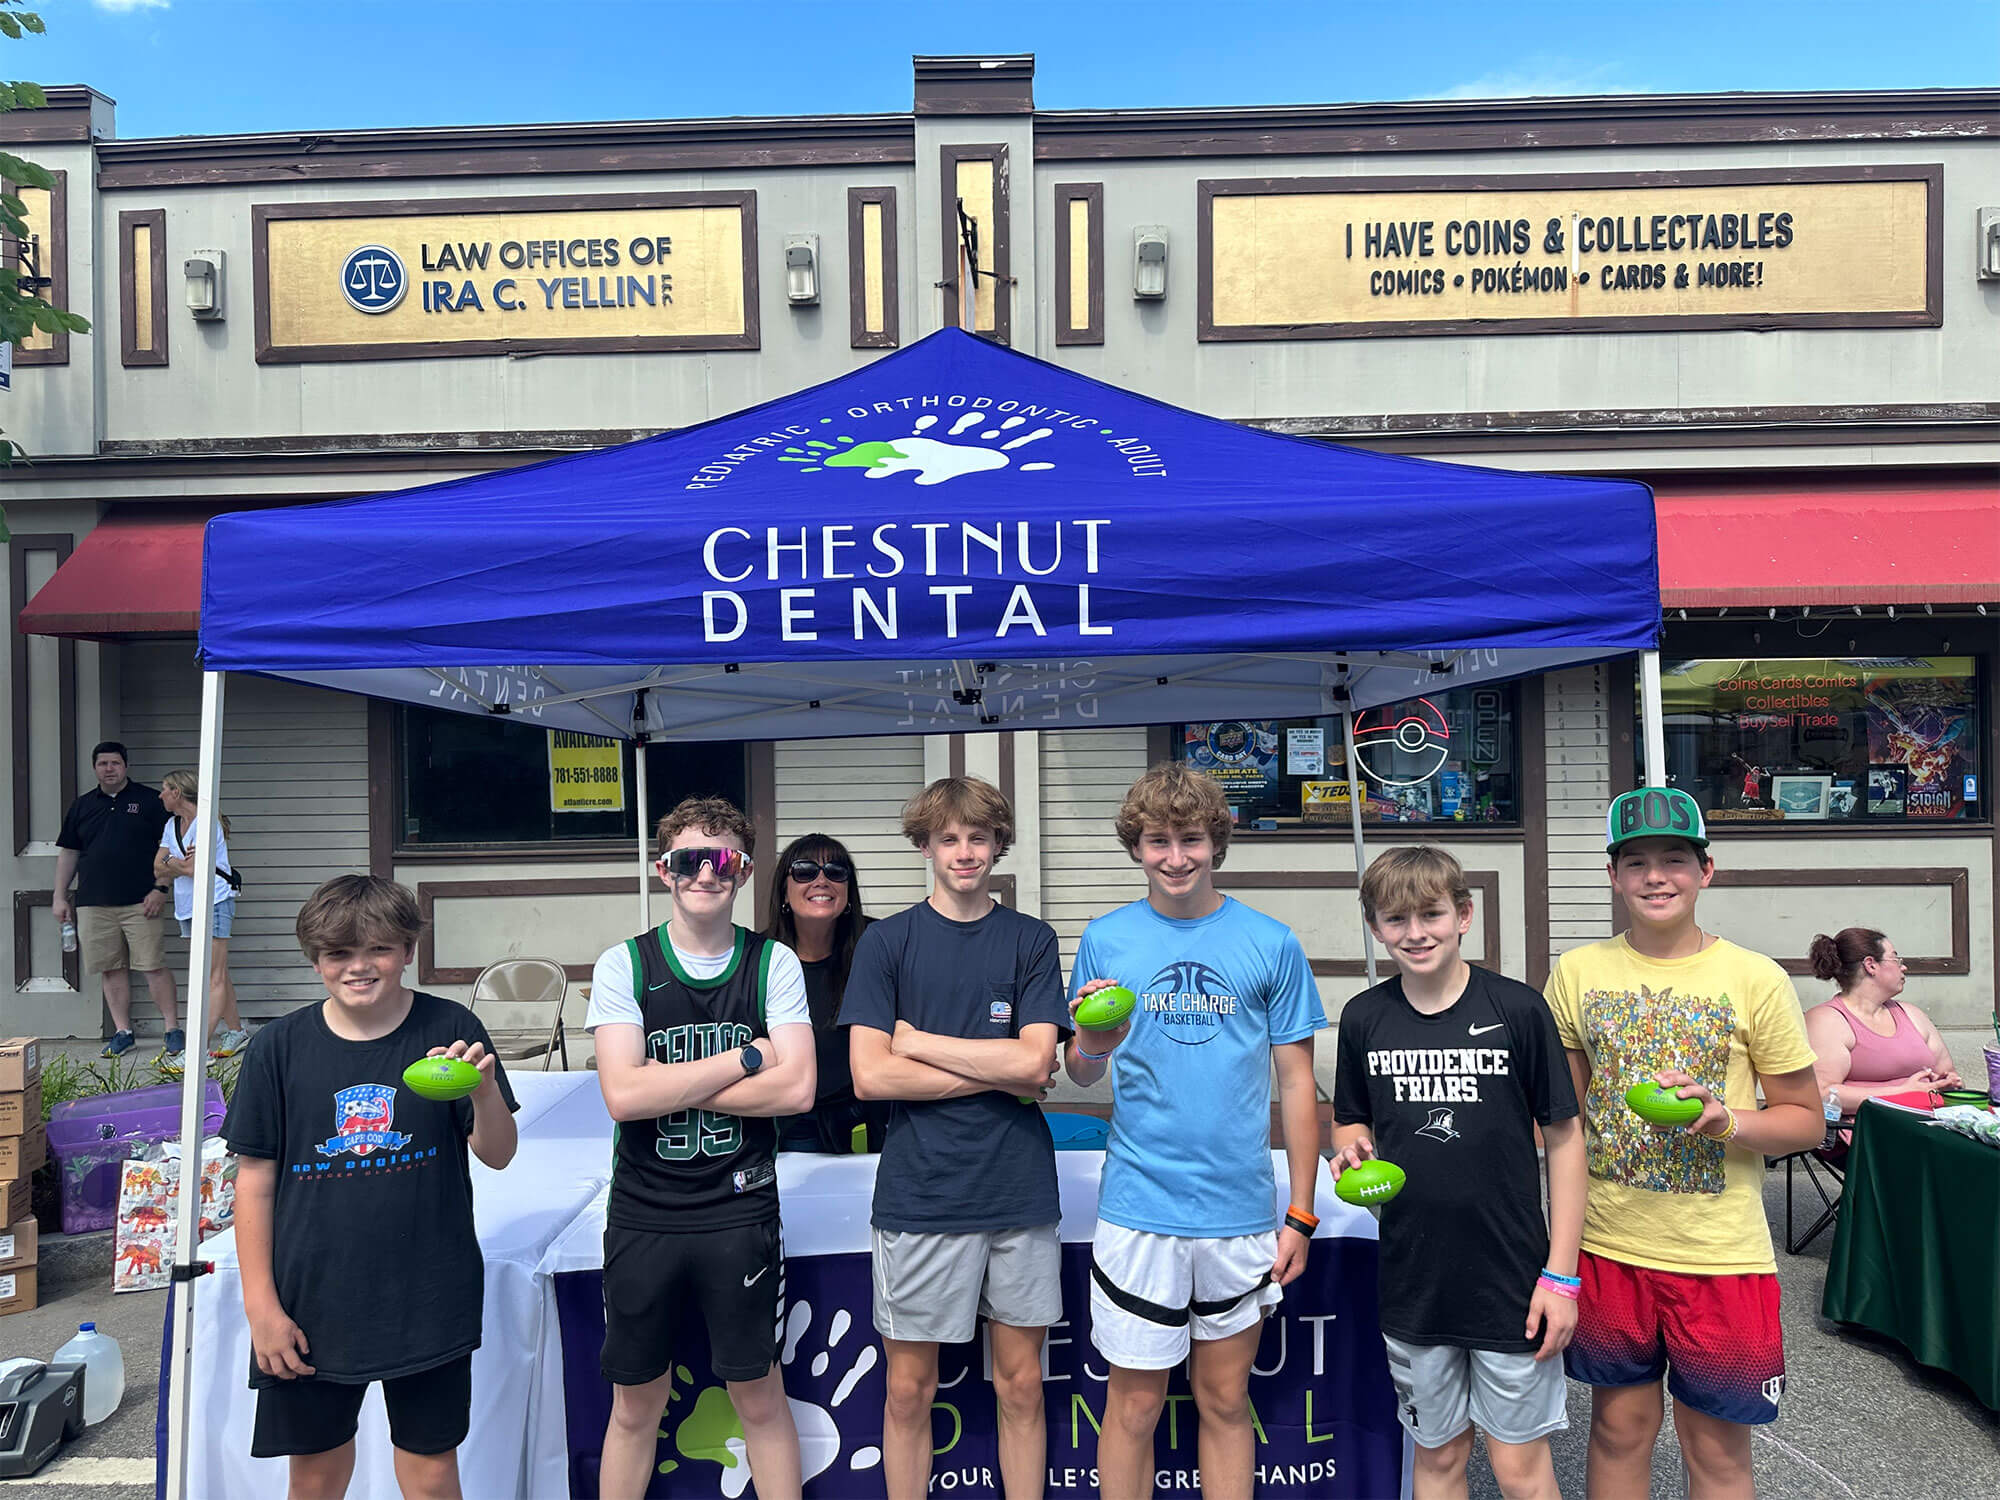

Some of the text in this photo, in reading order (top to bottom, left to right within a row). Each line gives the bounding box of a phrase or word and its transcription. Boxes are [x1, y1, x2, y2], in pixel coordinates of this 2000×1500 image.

[1345, 212, 1795, 259] I HAVE COINS & COLLECTABLES
[421, 236, 672, 272] LAW OFFICES OF
[1370, 260, 1764, 297] COMICS POKÉMON CARDS & MORE!
[422, 279, 486, 312] IRA
[492, 278, 527, 311] C.
[537, 274, 656, 309] YELLIN
[685, 394, 1168, 491] PEDIATRIC ORTHODONTIC ADULT
[702, 519, 1112, 583] CHESTNUT
[701, 583, 1113, 642] DENTAL
[1718, 673, 1857, 691] Coins Cards Comics
[1746, 694, 1830, 710] Collectibles
[1477, 695, 1496, 759] OPEN
[1739, 711, 1839, 732] Buy Sell Trade
[554, 767, 618, 783] 781-551-8888
[1620, 791, 1691, 835] BOS
[1907, 791, 1951, 808] SIDIAN
[1907, 806, 1946, 815] LAMES
[1141, 992, 1177, 1012] TAKE
[1181, 993, 1237, 1015] CHARGE
[1164, 1013, 1215, 1026] BASKETBALL
[1367, 1049, 1509, 1076] PROVIDENCE
[1393, 1076, 1483, 1102] FRIARS.
[345, 1133, 384, 1147] CAPE COD
[928, 1467, 995, 1493] YOUR
[1155, 1469, 1201, 1489] GRE
[1253, 1458, 1336, 1485] HANDS
